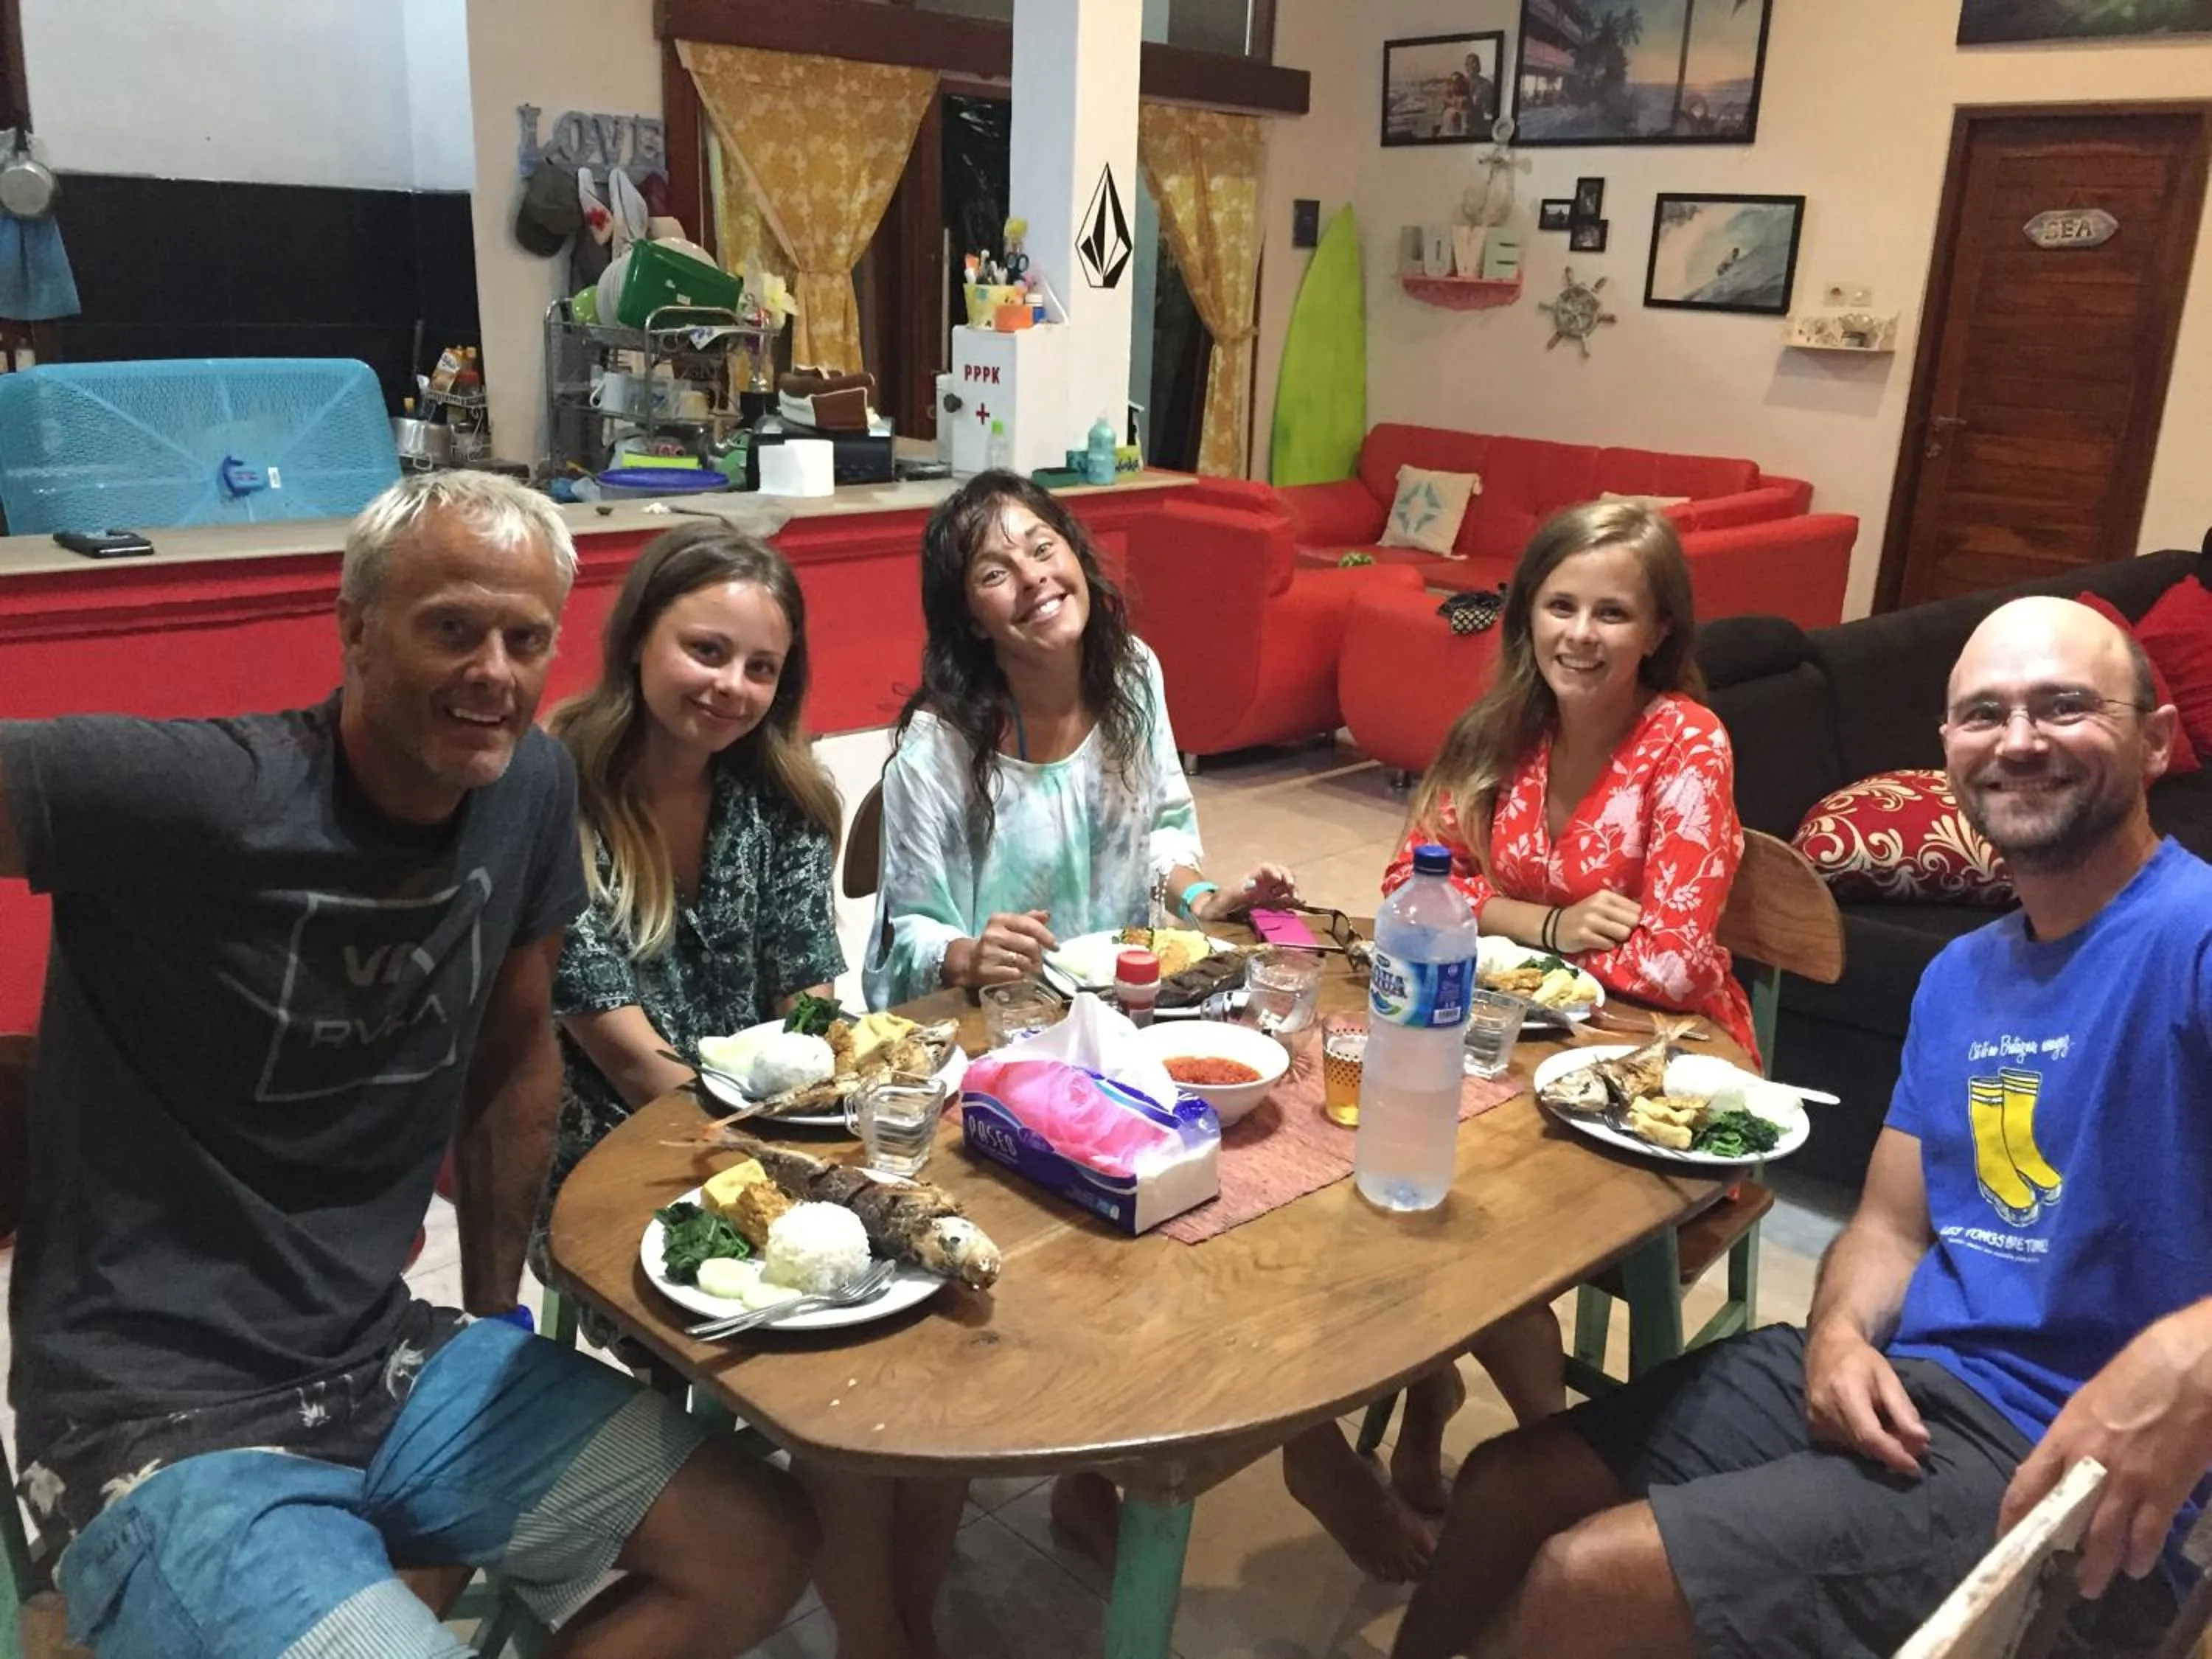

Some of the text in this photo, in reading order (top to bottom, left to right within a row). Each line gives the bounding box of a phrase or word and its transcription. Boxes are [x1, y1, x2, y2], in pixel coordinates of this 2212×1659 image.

[517, 105, 668, 178] LOVE
[2045, 217, 2093, 240] SEA
[1401, 225, 1520, 279] LOVE
[964, 364, 1001, 385] PPPK
